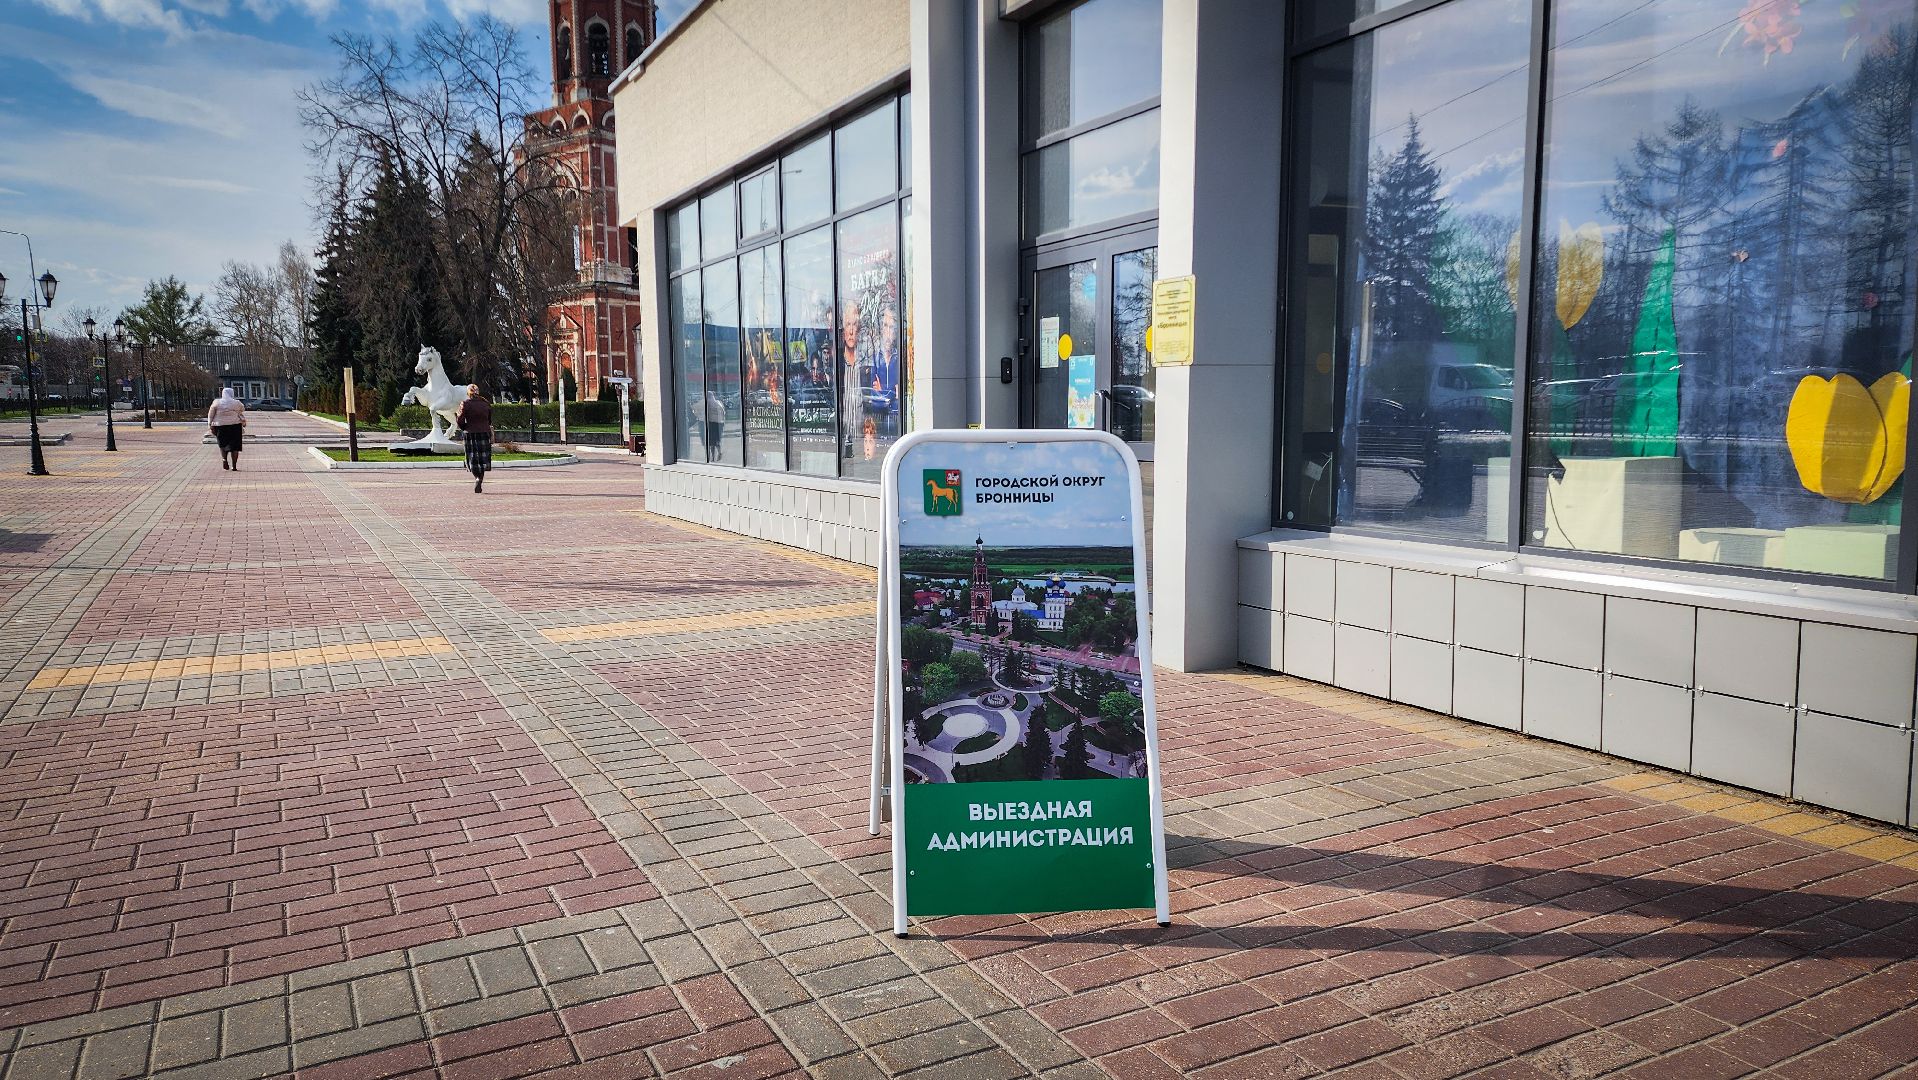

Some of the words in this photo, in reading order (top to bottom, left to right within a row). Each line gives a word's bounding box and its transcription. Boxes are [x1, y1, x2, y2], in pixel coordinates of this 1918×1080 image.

[975, 474, 1059, 488] ГОРОДСКОЙ
[1062, 475, 1106, 487] ОКРУГ
[976, 492, 1054, 504] БРОННИЦЫ
[968, 800, 1092, 822] ВЫЕЗДНАЯ
[927, 826, 1134, 852] АДМИНИСТРАЦИЯ
